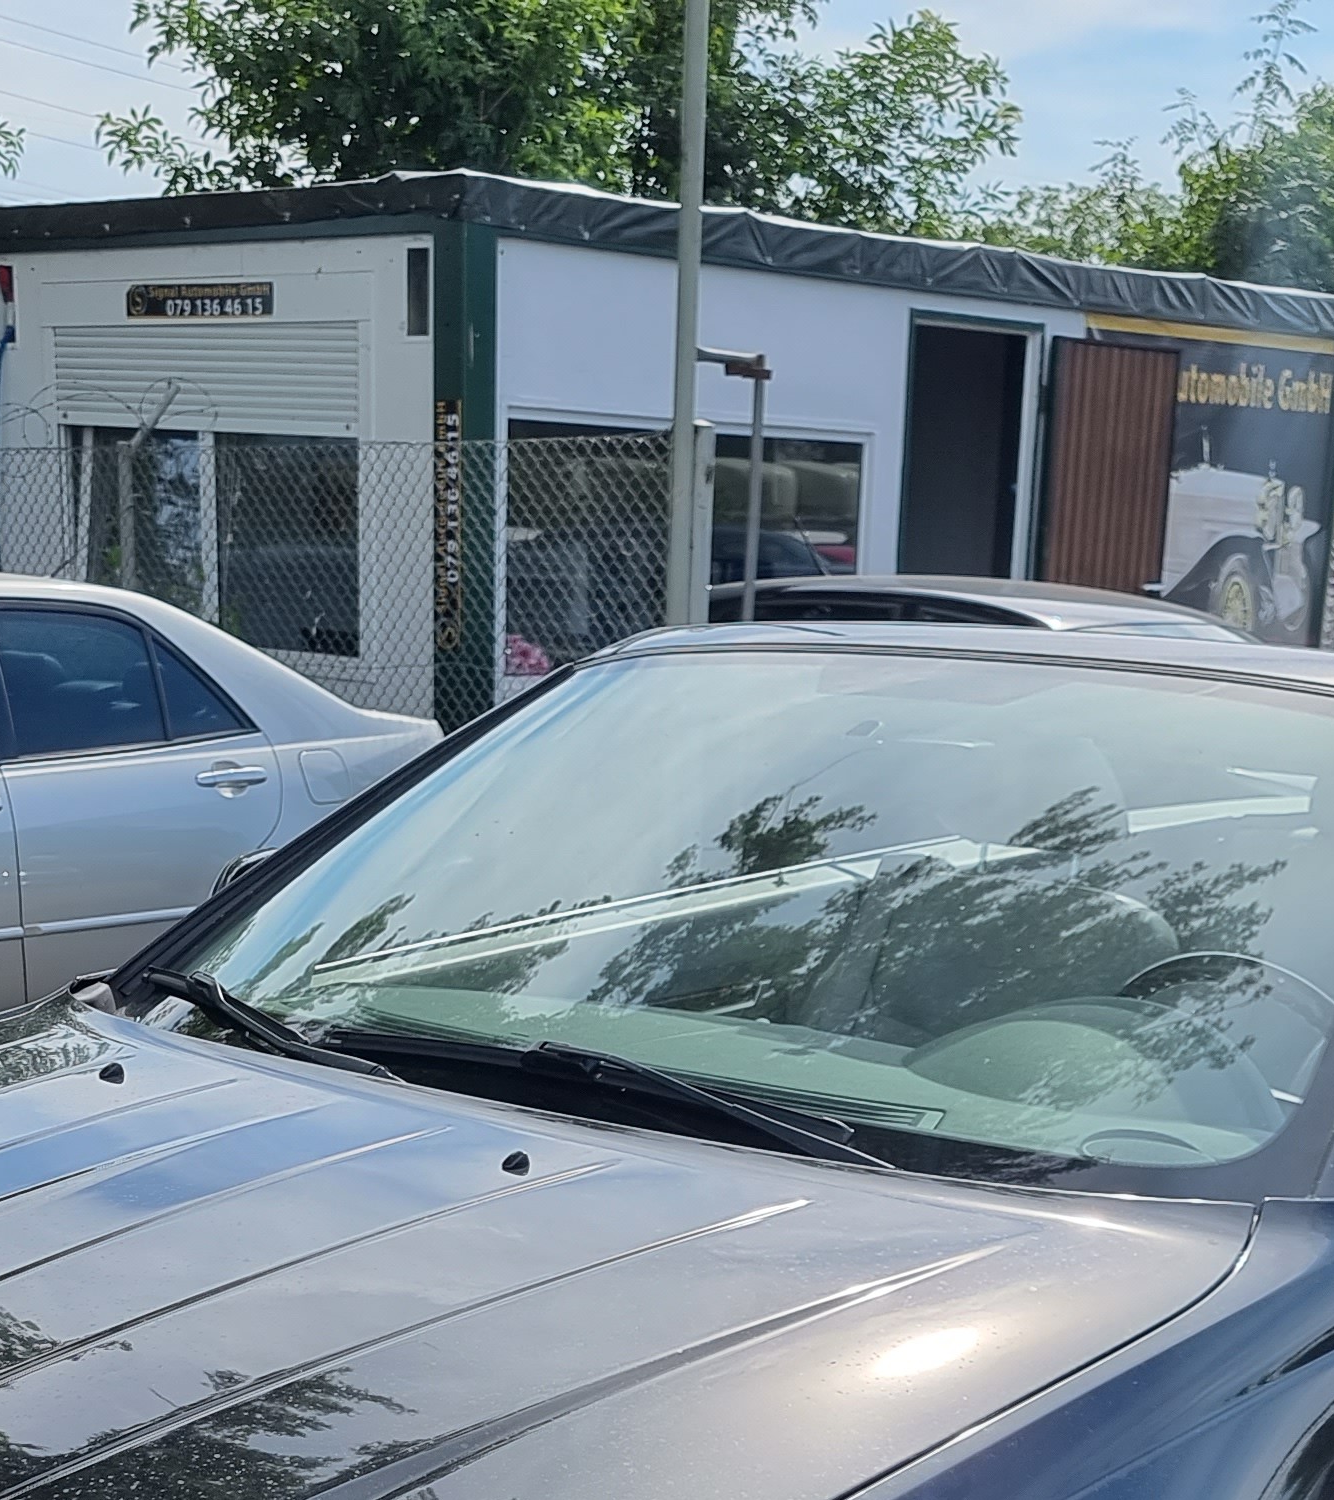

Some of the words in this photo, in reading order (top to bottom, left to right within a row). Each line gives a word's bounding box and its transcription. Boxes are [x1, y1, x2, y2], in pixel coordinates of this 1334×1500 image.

[167, 299, 192, 316] 079
[195, 298, 221, 316] 136
[224, 298, 242, 316] 46
[246, 297, 264, 316] 15
[1177, 362, 1275, 409] utomobile
[1278, 369, 1334, 414] GmbH
[446, 413, 459, 439] 15
[447, 539, 459, 583] 079
